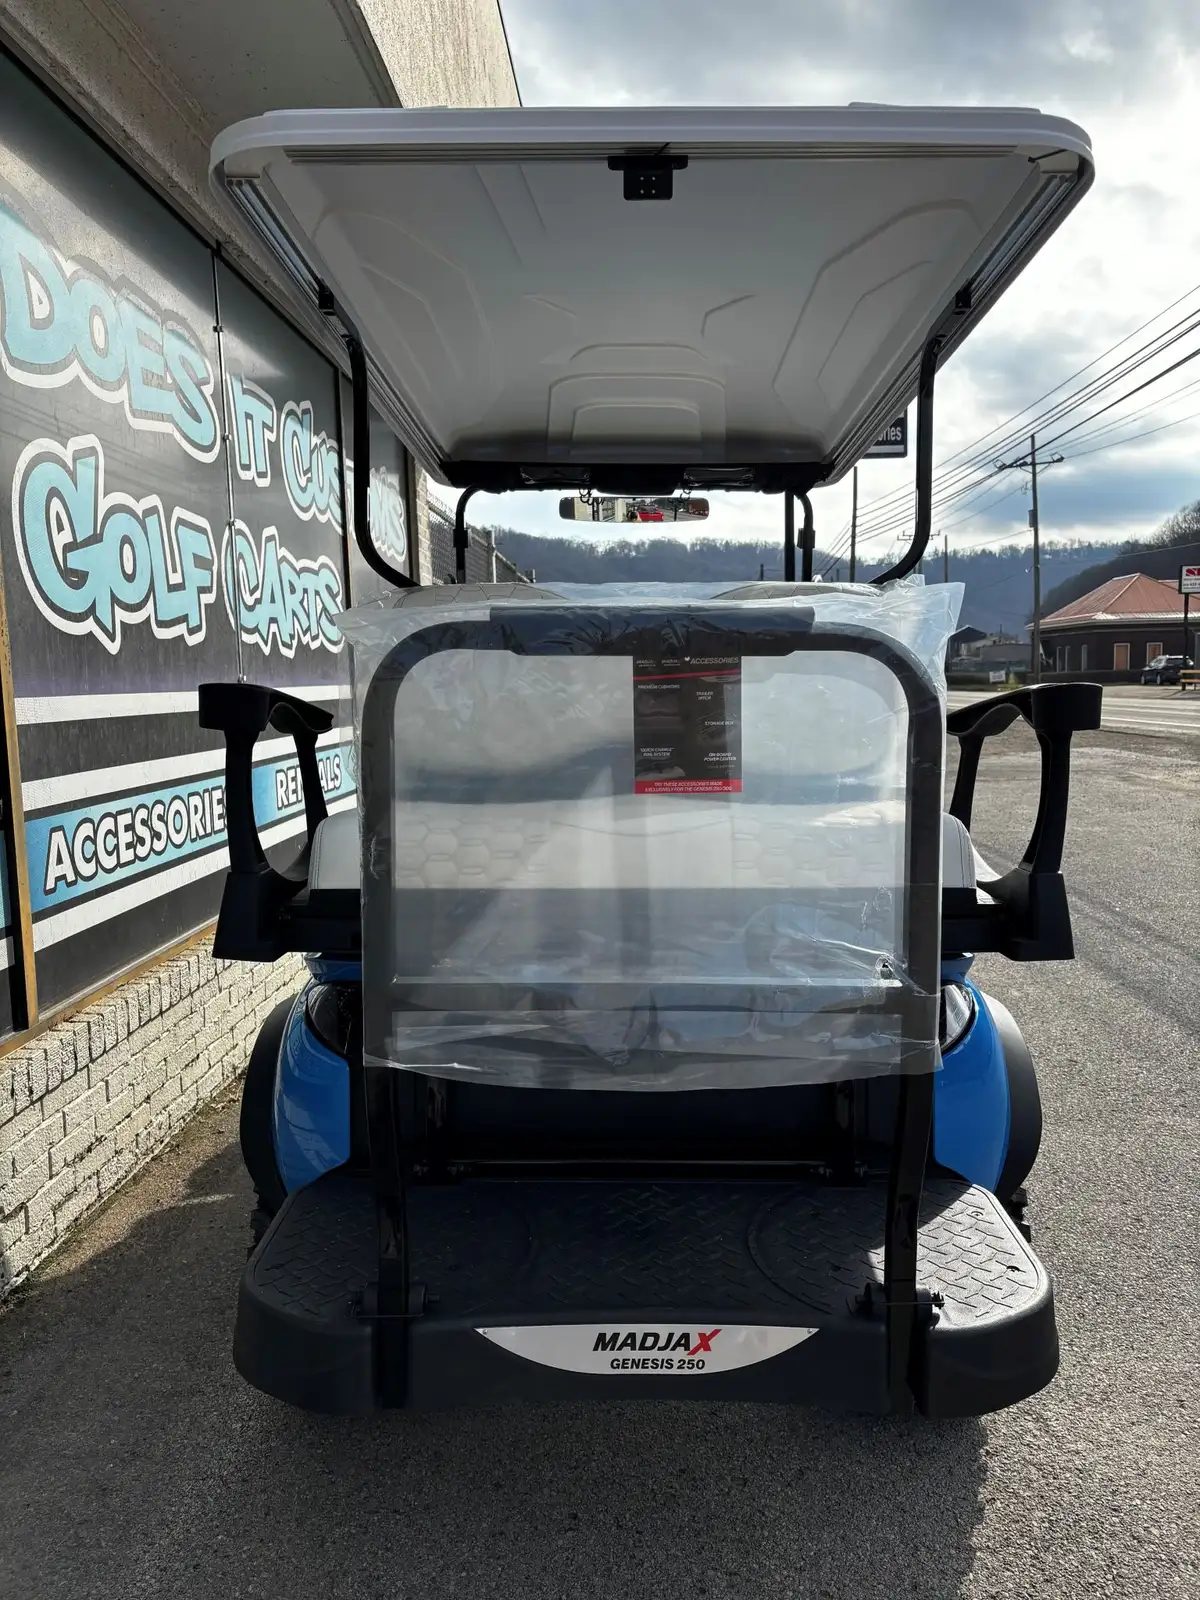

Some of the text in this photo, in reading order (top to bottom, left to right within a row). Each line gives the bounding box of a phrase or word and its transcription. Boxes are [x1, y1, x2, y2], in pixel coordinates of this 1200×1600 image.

[0, 200, 218, 460] DOES
[228, 373, 276, 485] IT
[13, 436, 345, 656] GOLF CARTS
[690, 657, 739, 666] ACCESSORIES
[44, 790, 227, 895] ACCESSORIE
[592, 1328, 722, 1356] MADJAX
[610, 1358, 706, 1370] GENESIS 250
